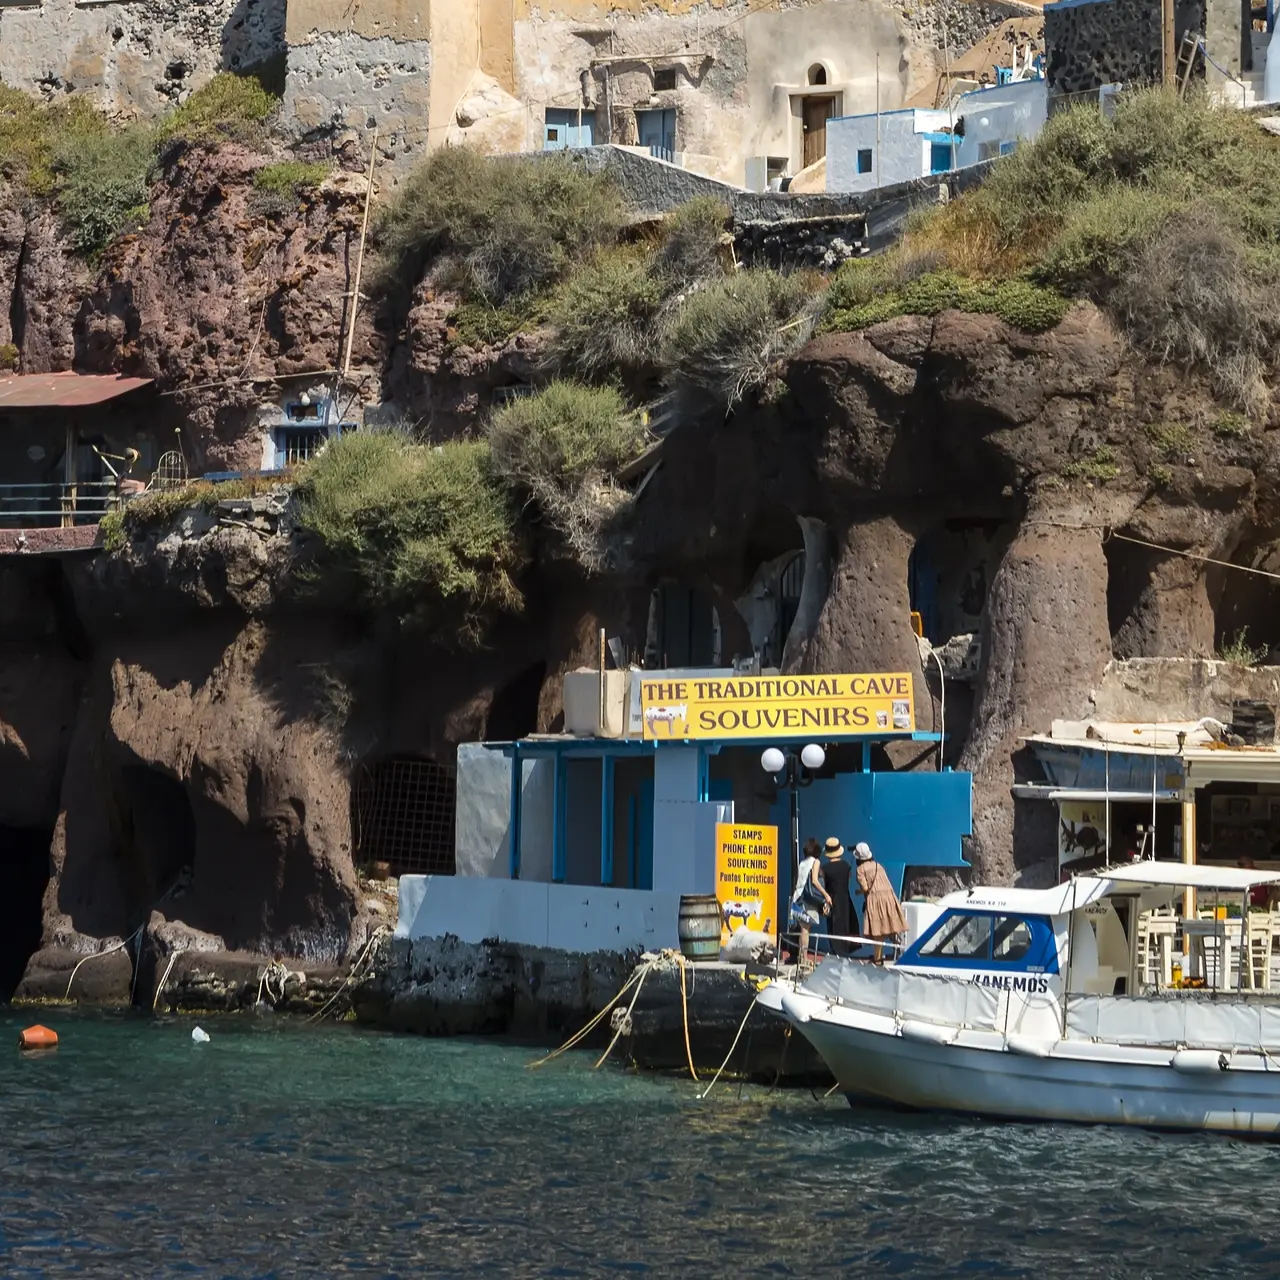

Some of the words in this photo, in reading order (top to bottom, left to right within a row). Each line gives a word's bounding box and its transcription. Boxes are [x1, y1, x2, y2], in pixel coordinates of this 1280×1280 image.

[643, 682, 689, 701] THE
[693, 678, 844, 700] TRADITIONAL
[850, 677, 910, 696] CAVE
[699, 706, 870, 731] SOUVENIRS
[733, 829, 762, 840] STAMPS
[722, 843, 746, 854] PHONE
[748, 844, 772, 855] CARDS
[727, 858, 767, 869] SOUVENIRS
[720, 871, 741, 882] Puntos
[734, 886, 759, 897] Regalos
[982, 975, 1049, 994] ANEMOS
